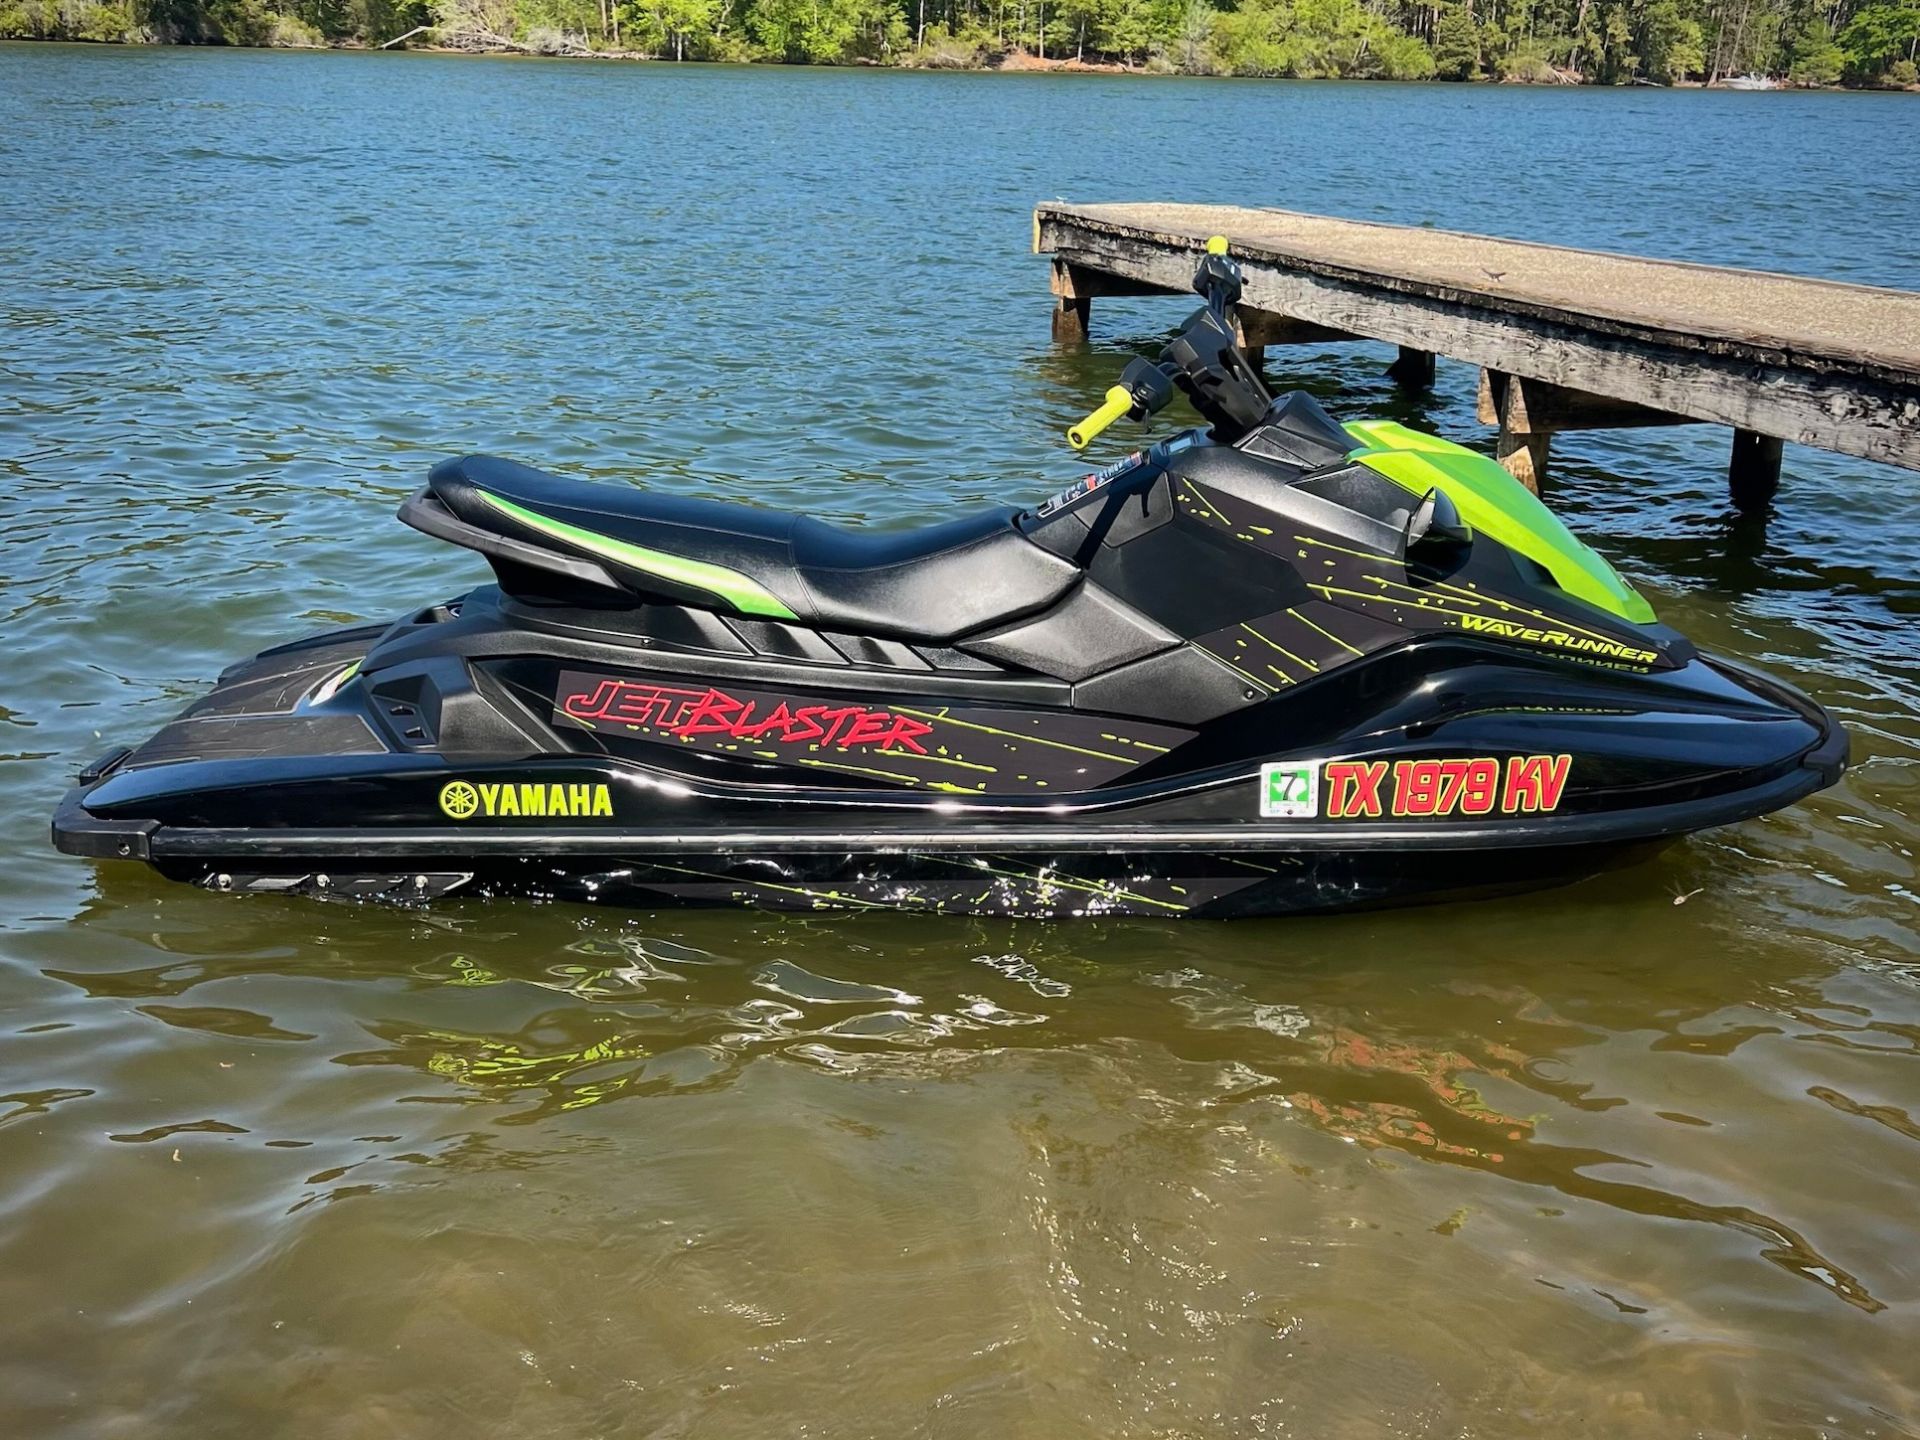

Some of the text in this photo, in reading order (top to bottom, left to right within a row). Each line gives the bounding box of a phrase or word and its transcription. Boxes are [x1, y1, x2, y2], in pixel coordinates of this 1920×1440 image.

[1461, 615, 1658, 663] WAVERUNNER
[565, 680, 934, 755] JETBLASTER
[478, 783, 614, 817] YAMAHA
[1280, 772, 1298, 801] 7
[1325, 761, 1389, 817] TX
[1391, 757, 1500, 816] 1979
[1502, 754, 1573, 813] KV
